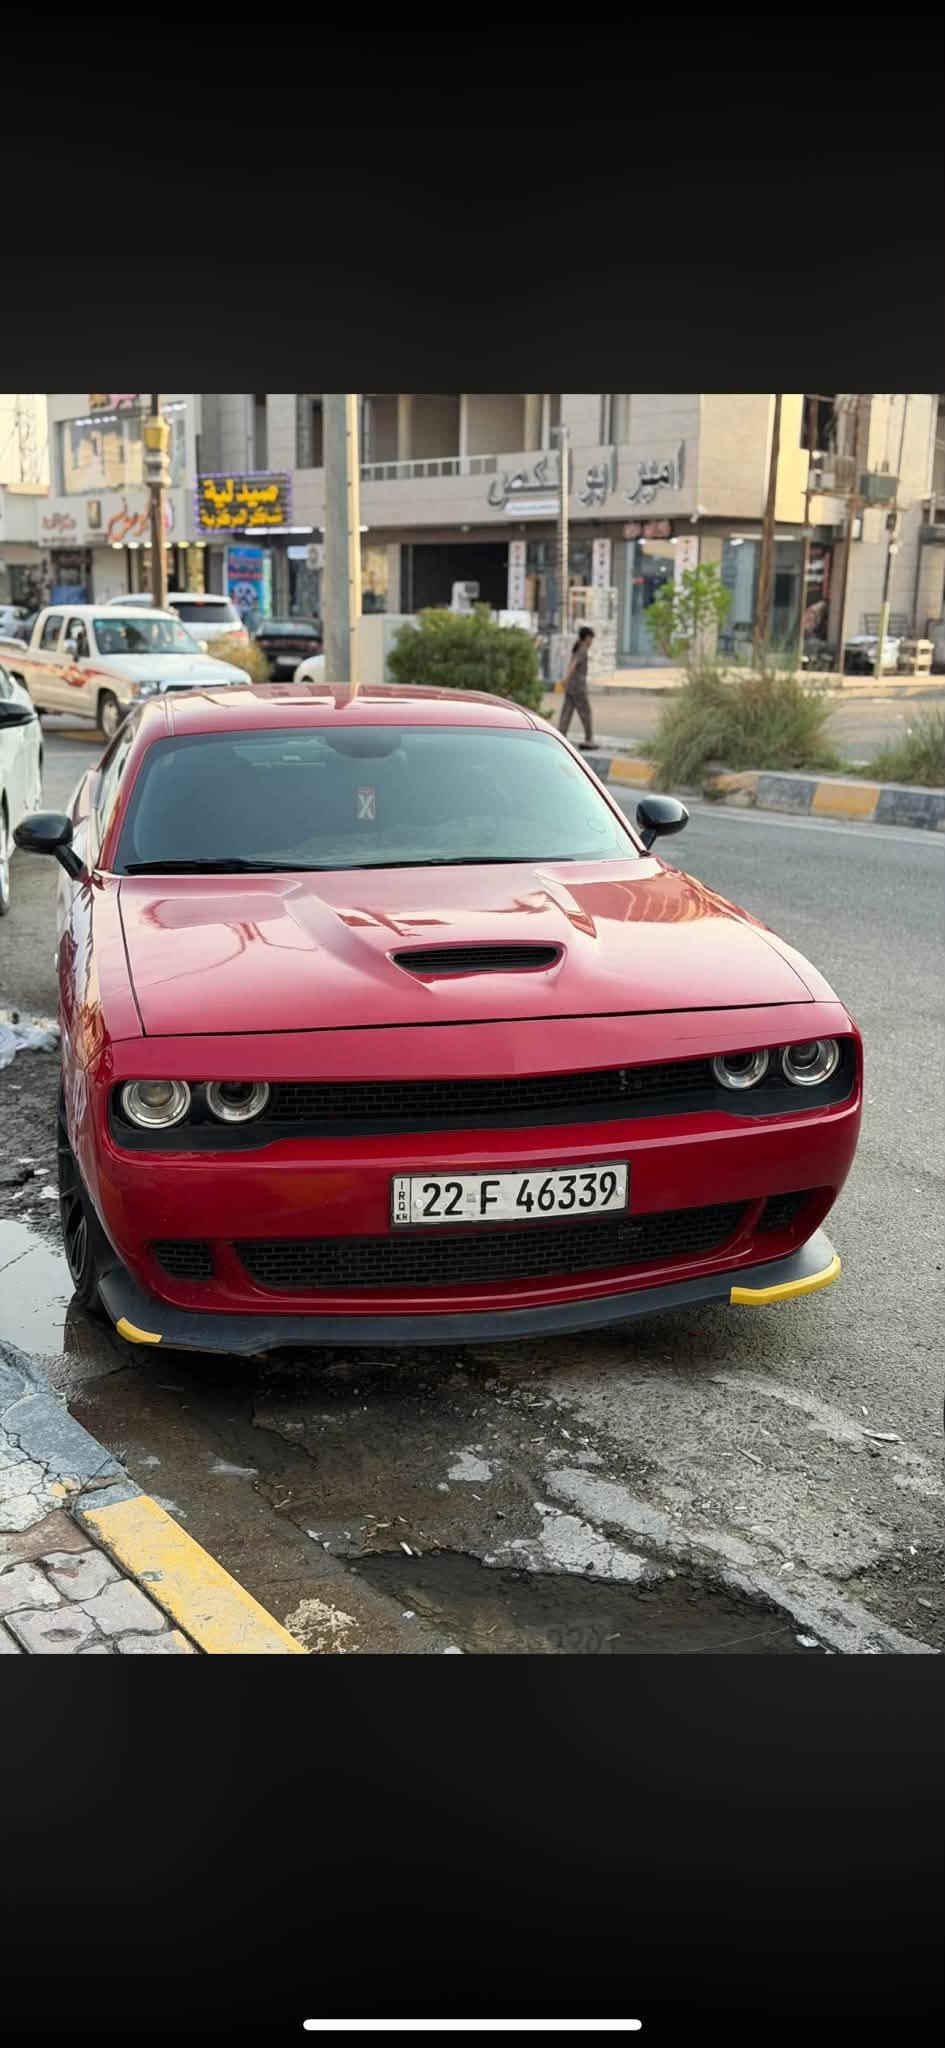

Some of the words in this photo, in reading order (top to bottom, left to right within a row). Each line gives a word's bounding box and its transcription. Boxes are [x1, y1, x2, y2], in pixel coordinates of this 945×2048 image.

[203, 479, 279, 508] صيدلية
[421, 1182, 464, 1217] 22
[479, 1180, 501, 1215] F
[515, 1171, 618, 1213] 46339
